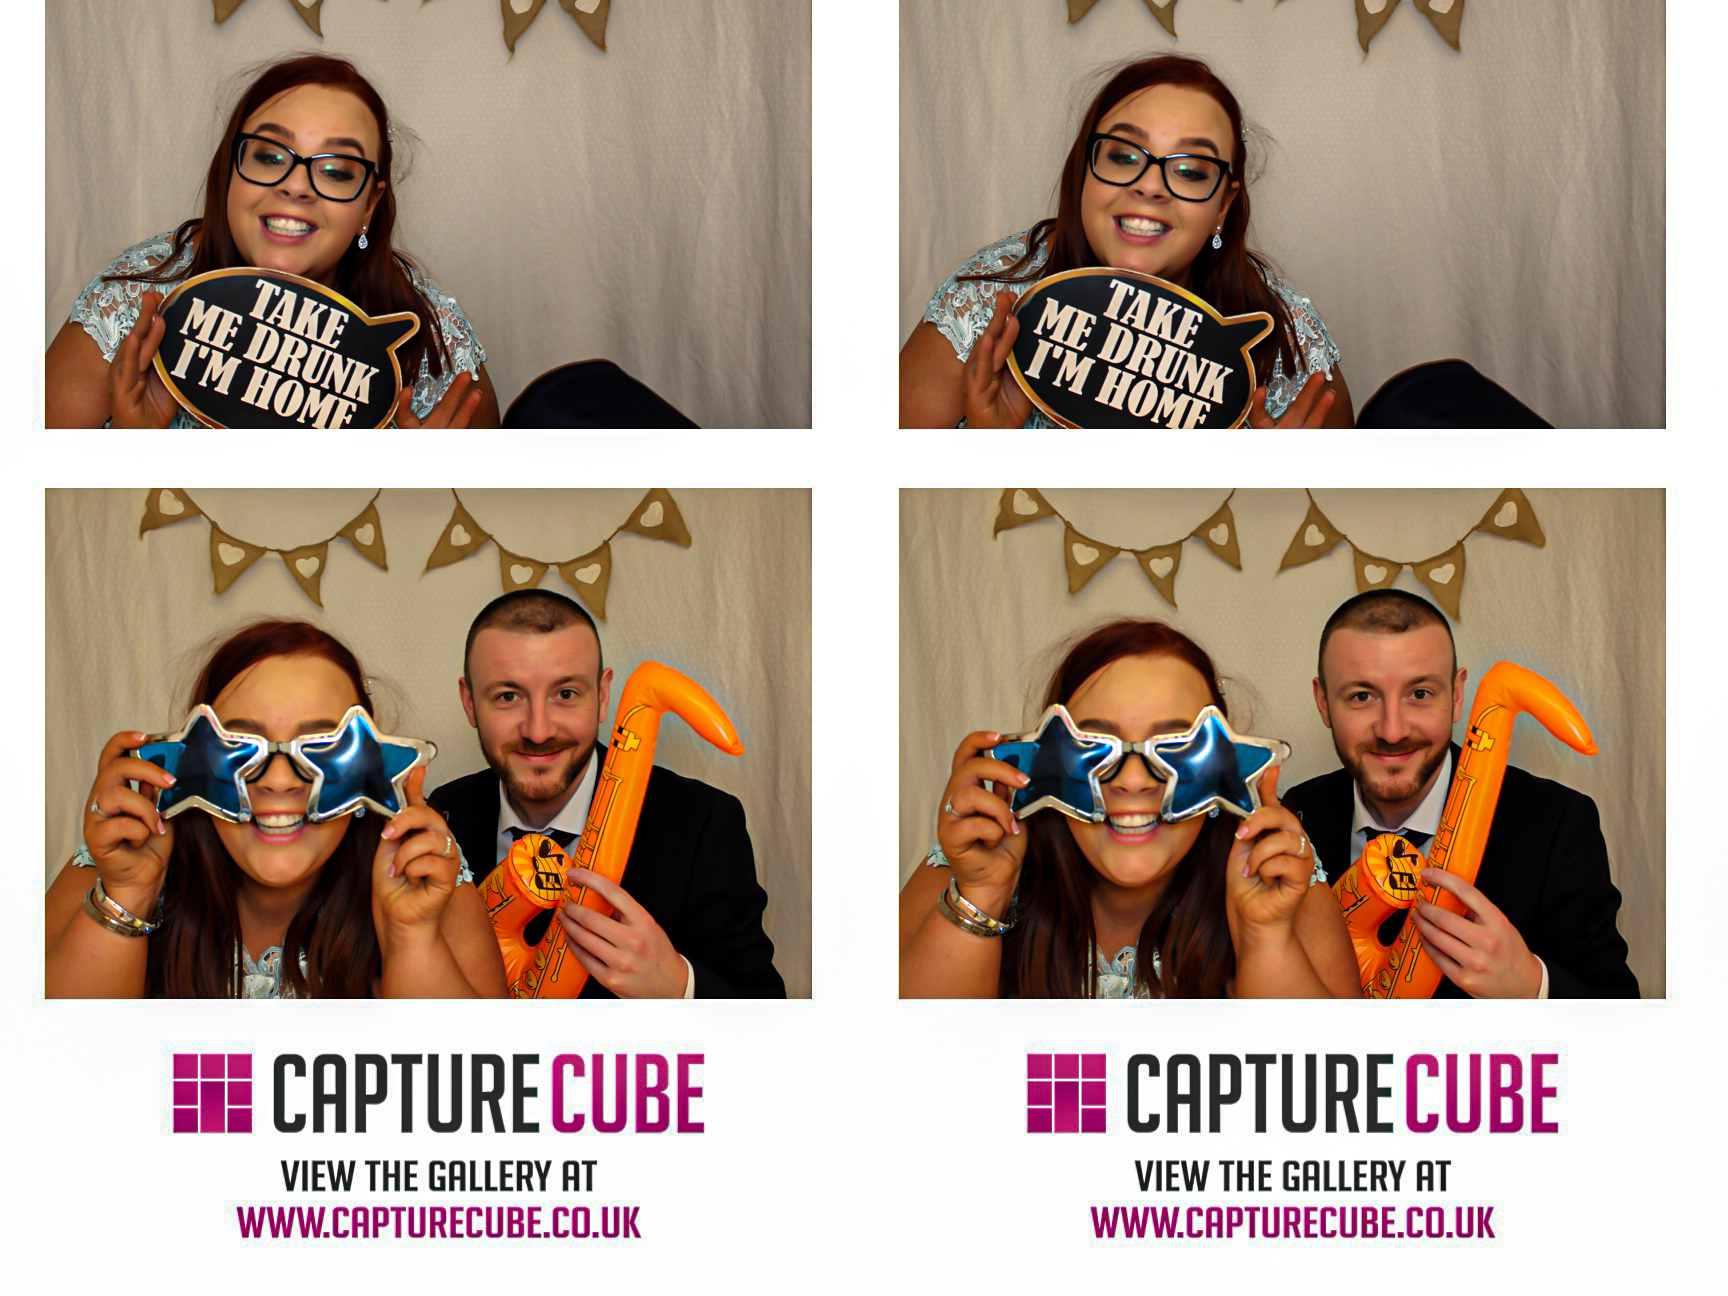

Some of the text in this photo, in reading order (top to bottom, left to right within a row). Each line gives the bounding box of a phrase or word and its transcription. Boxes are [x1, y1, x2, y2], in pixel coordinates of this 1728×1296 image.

[249, 278, 350, 349] TAKE
[1103, 278, 1204, 349] TAKE
[170, 338, 242, 396] I'M
[179, 297, 380, 404] ME DRUNK
[1024, 338, 1096, 396] I'M
[1033, 297, 1234, 404] ME DRUNK
